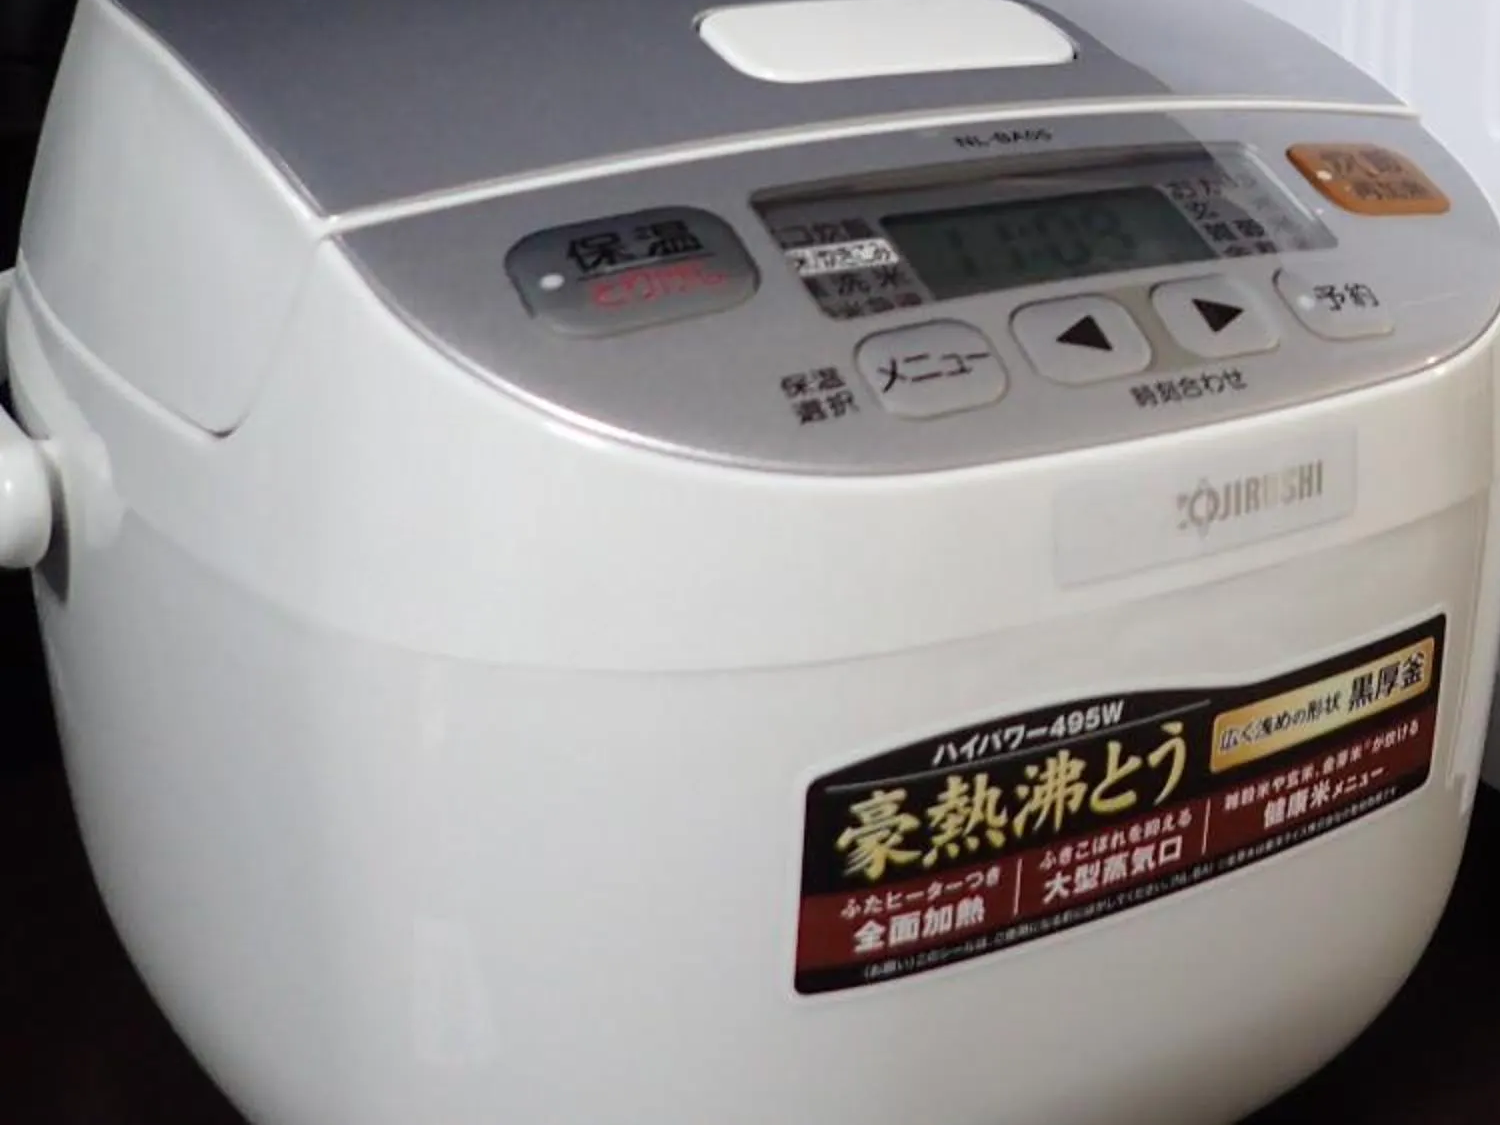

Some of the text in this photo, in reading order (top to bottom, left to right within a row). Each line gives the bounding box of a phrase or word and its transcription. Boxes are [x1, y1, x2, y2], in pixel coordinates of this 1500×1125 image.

[567, 219, 706, 273] 保温
[1312, 283, 1380, 313] 予約
[878, 352, 992, 393] メニュー
[1130, 369, 1248, 407] 時刻合わせ
[1347, 651, 1425, 713] 黒厚釜
[931, 699, 1125, 768] ハイパワー495W
[834, 721, 1187, 881] 豪熱沸とう
[840, 865, 1002, 920] ふたヒーターつき
[1043, 834, 1183, 905] 大型蒸気口
[852, 895, 987, 955] 全面加熱
